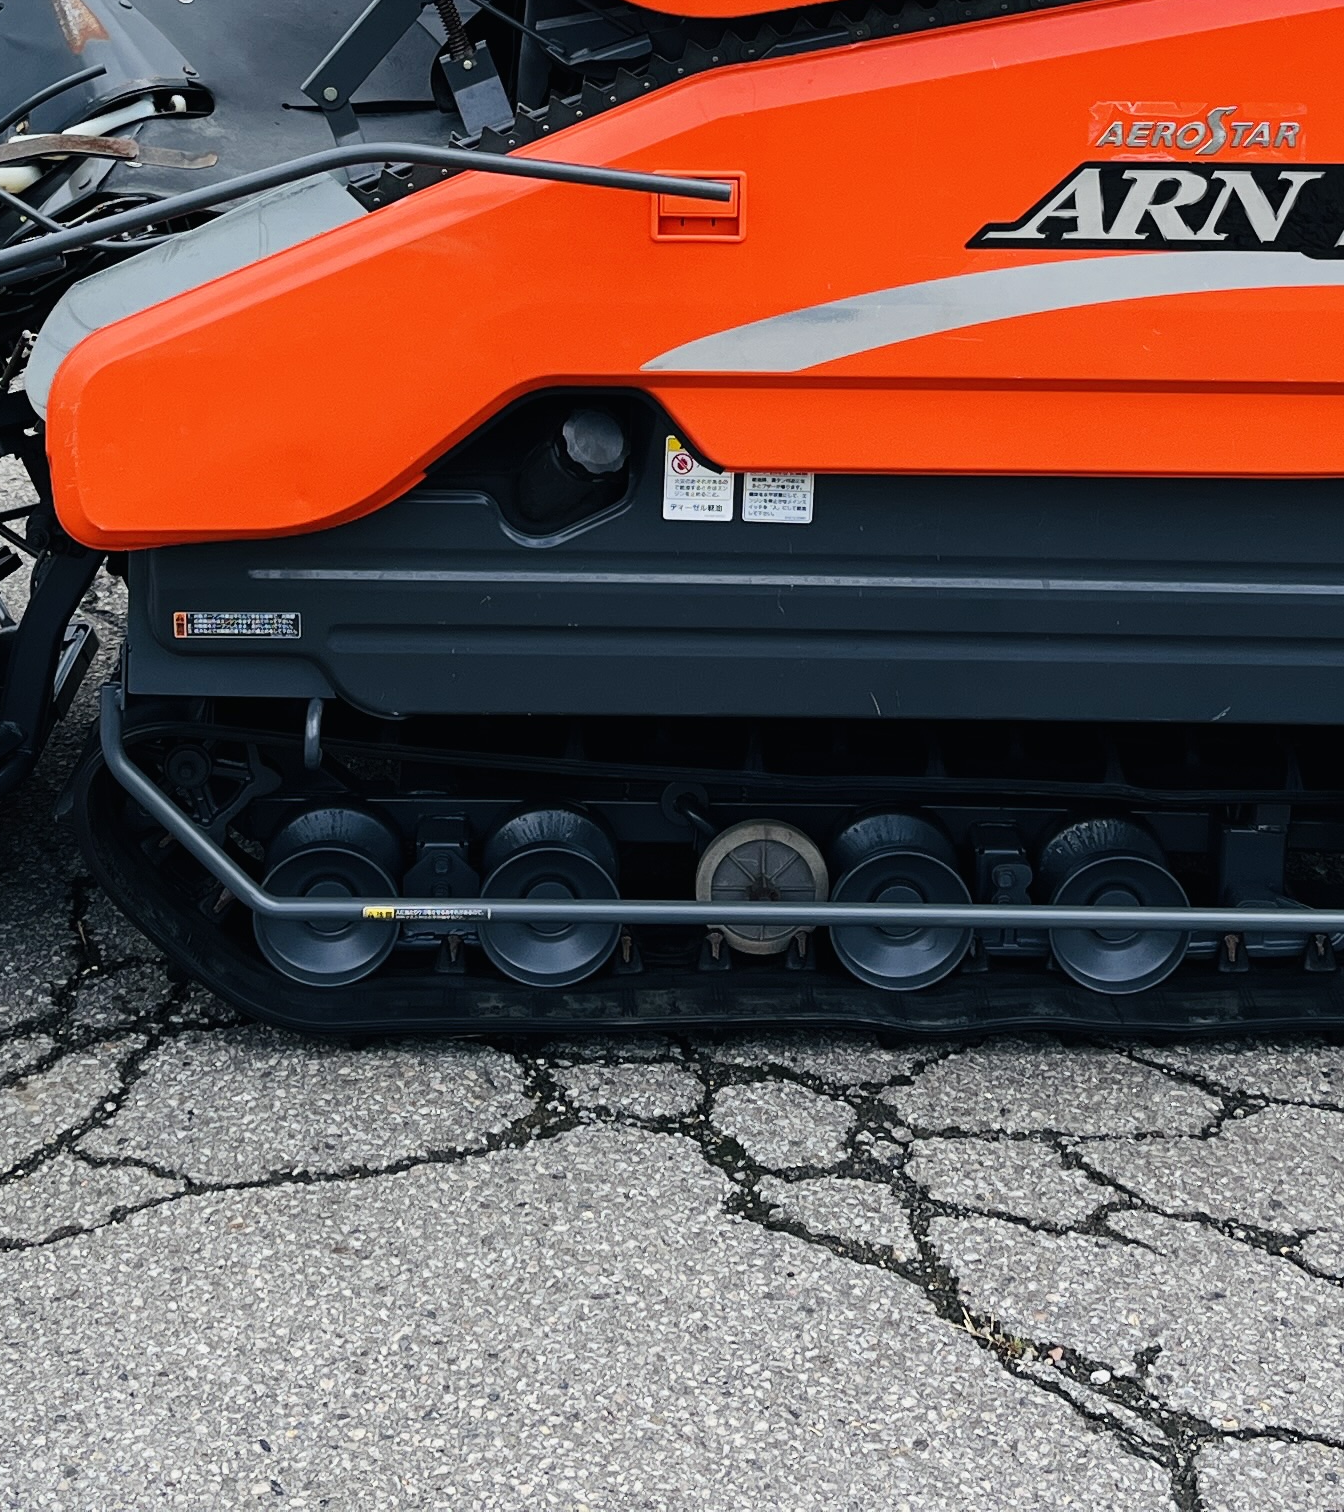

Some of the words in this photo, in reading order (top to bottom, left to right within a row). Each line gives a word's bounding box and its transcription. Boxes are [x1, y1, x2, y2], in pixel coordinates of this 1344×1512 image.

[1095, 106, 1301, 155] AEROSTAR
[983, 167, 1325, 244] ARN
[670, 503, 723, 513] ディーゼル軽油
